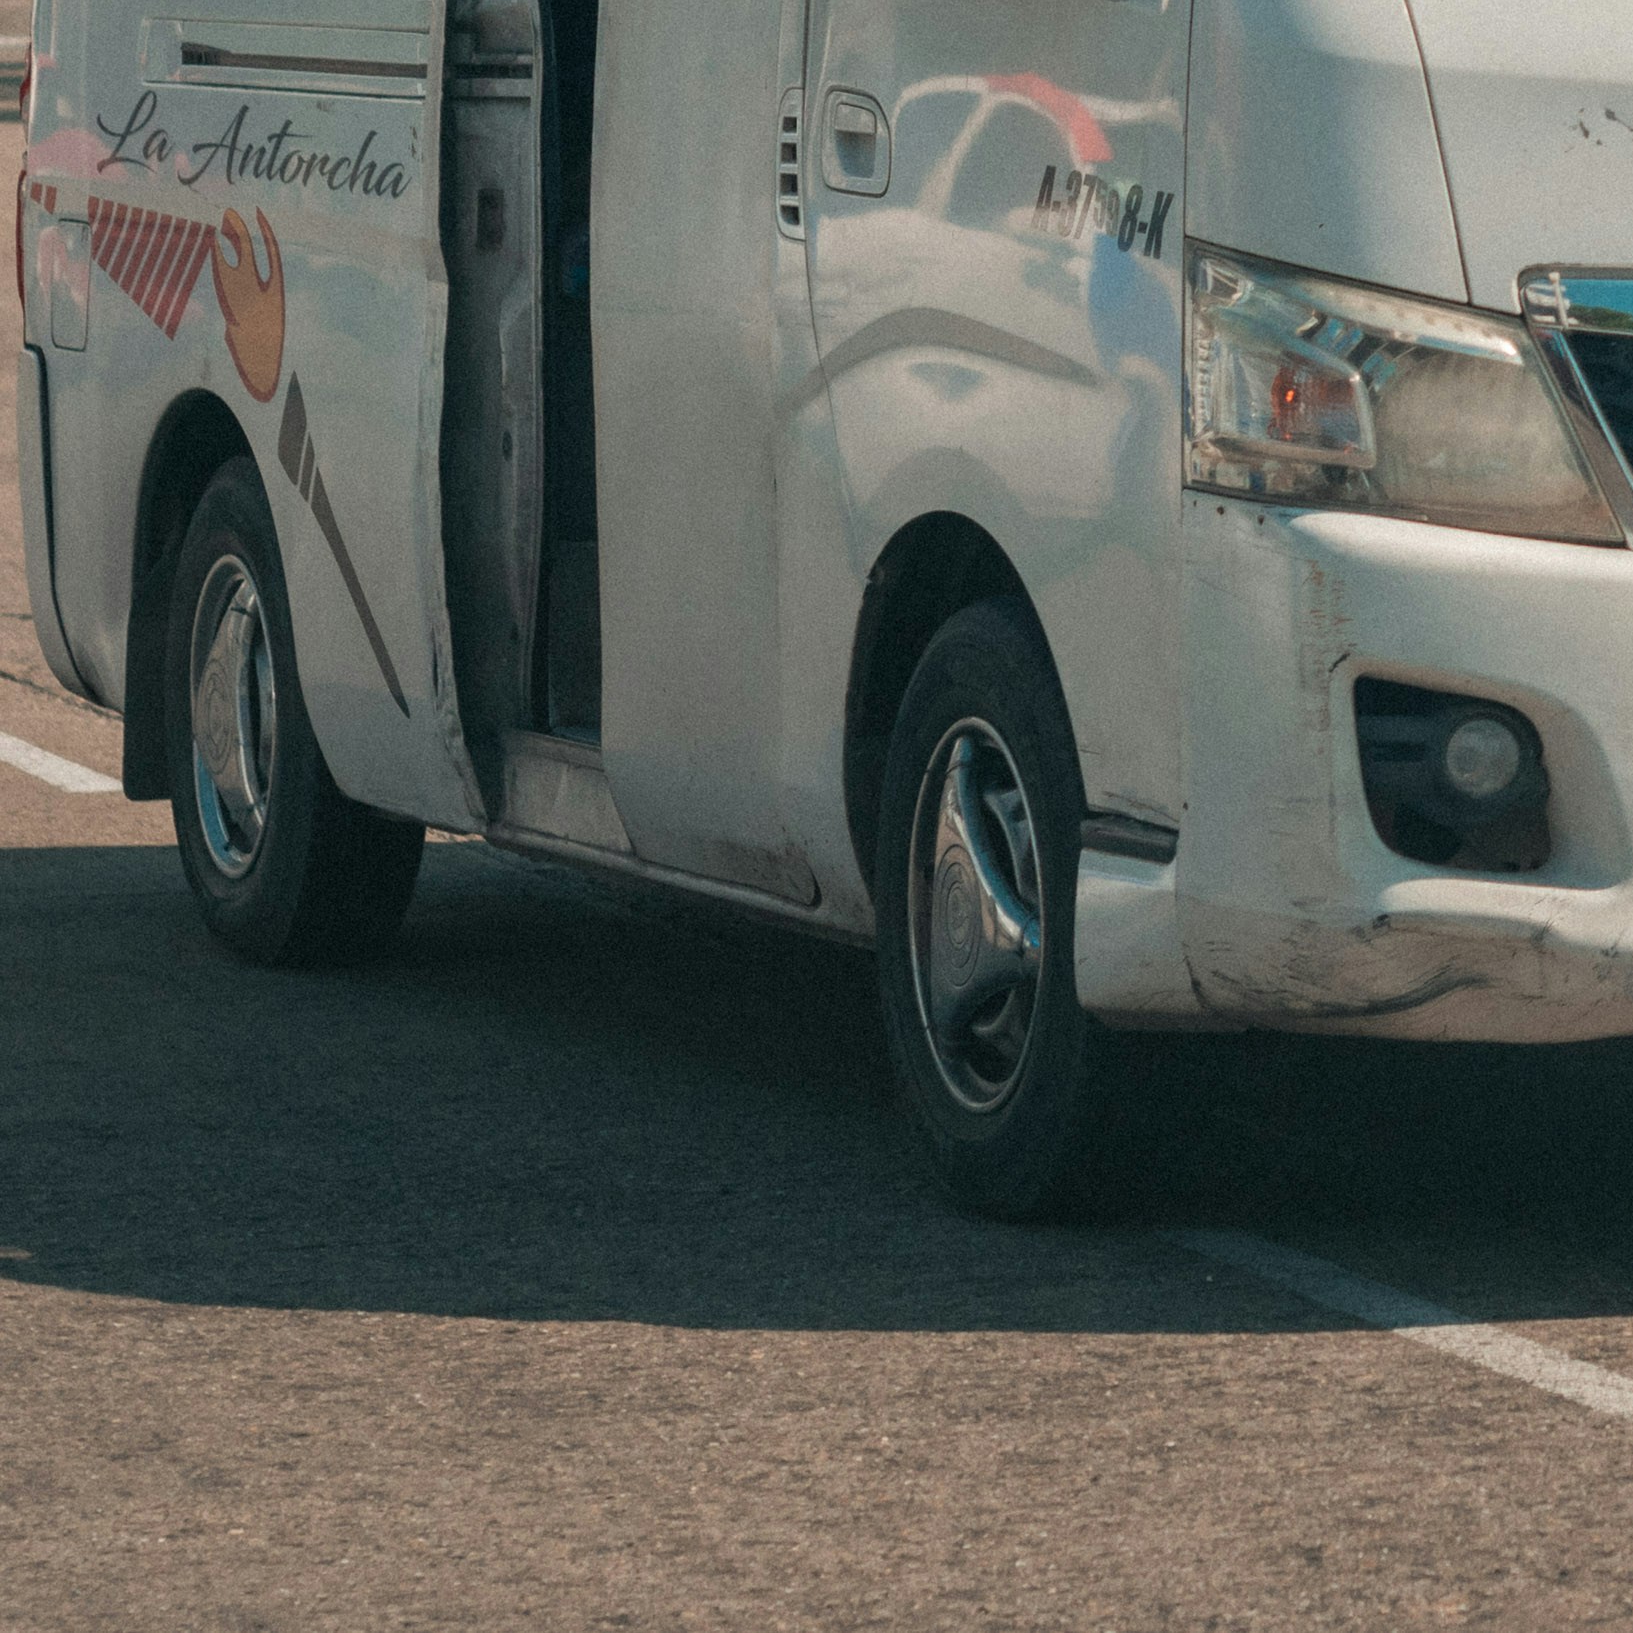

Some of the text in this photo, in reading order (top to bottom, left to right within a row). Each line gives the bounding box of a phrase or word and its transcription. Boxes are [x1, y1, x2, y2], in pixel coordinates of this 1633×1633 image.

[97, 90, 411, 199] La Antorcha
[1031, 165, 1174, 260] A-37598-K
